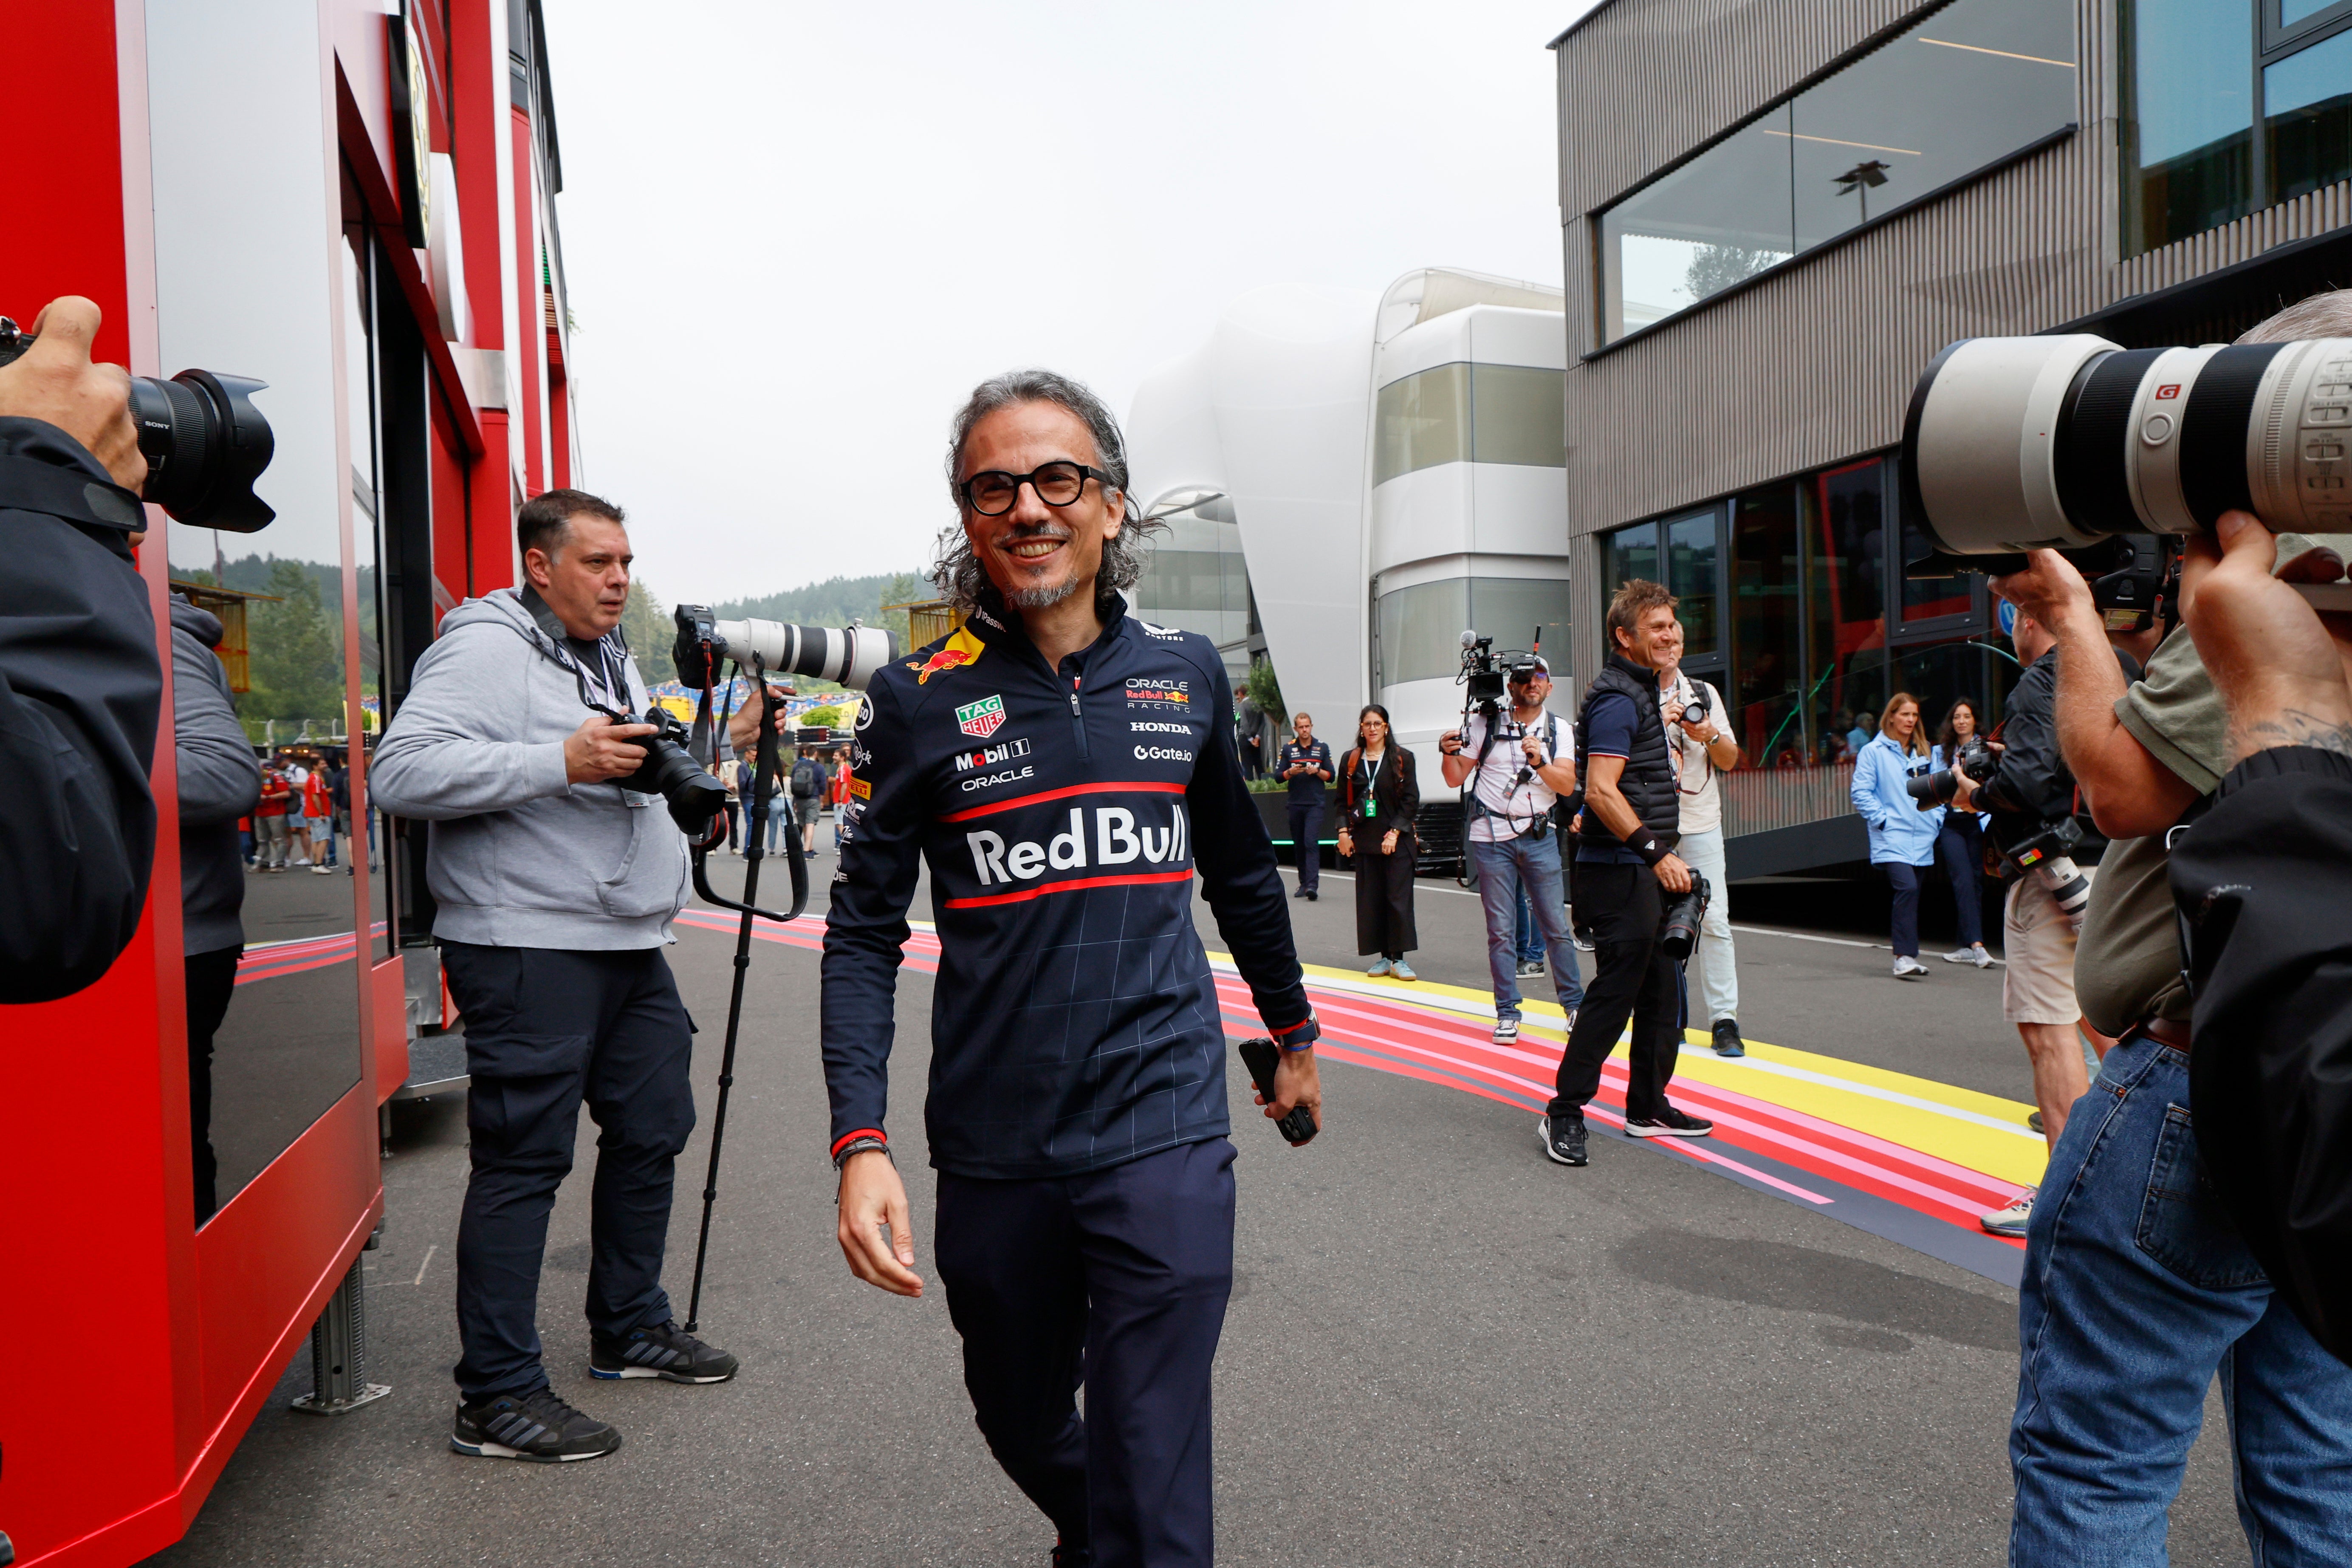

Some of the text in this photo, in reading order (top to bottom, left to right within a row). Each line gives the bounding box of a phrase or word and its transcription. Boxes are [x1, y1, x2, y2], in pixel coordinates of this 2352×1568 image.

[2160, 386, 2177, 398] G
[145, 421, 170, 429] SONY
[1126, 678, 1189, 691] ORACLE
[1126, 689, 1163, 700] Red Bull
[960, 699, 998, 719] TAG
[1127, 702, 1190, 713] RACING
[963, 712, 1003, 735] HEUER
[1130, 722, 1192, 735] HONDA
[855, 746, 872, 765] Rock
[955, 743, 1009, 771] Mobil
[1149, 746, 1192, 762] Gate.io
[962, 766, 1034, 791] ORACLE
[850, 784, 867, 796] ELLI
[967, 804, 1186, 885] Red Bull
